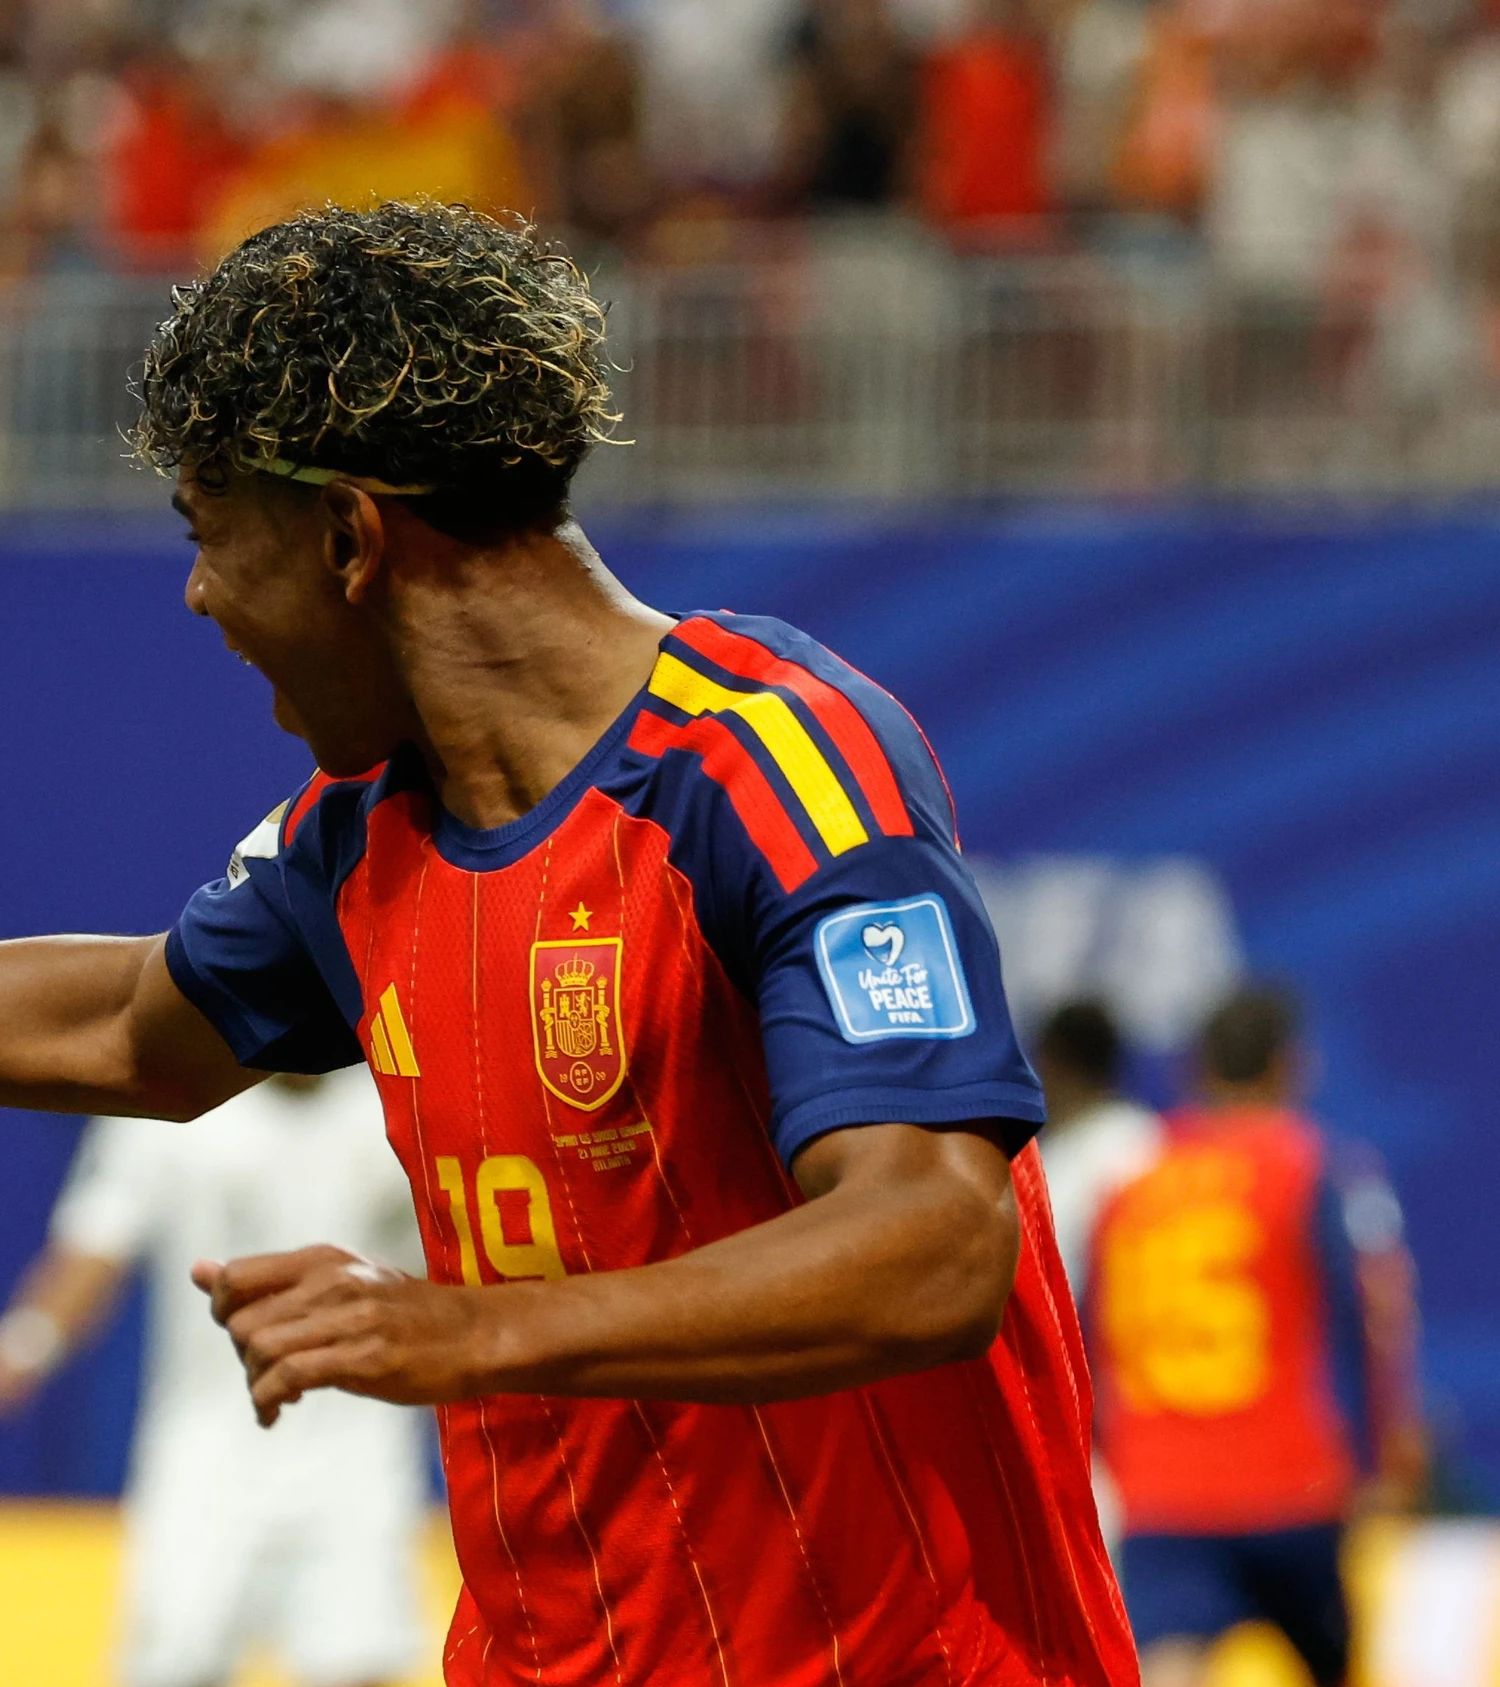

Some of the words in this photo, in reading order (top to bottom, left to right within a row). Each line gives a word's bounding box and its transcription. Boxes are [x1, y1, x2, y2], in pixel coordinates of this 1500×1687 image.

[868, 985, 934, 1011] PEACE
[887, 1011, 925, 1024] FIFA
[435, 1154, 568, 1289] 19
